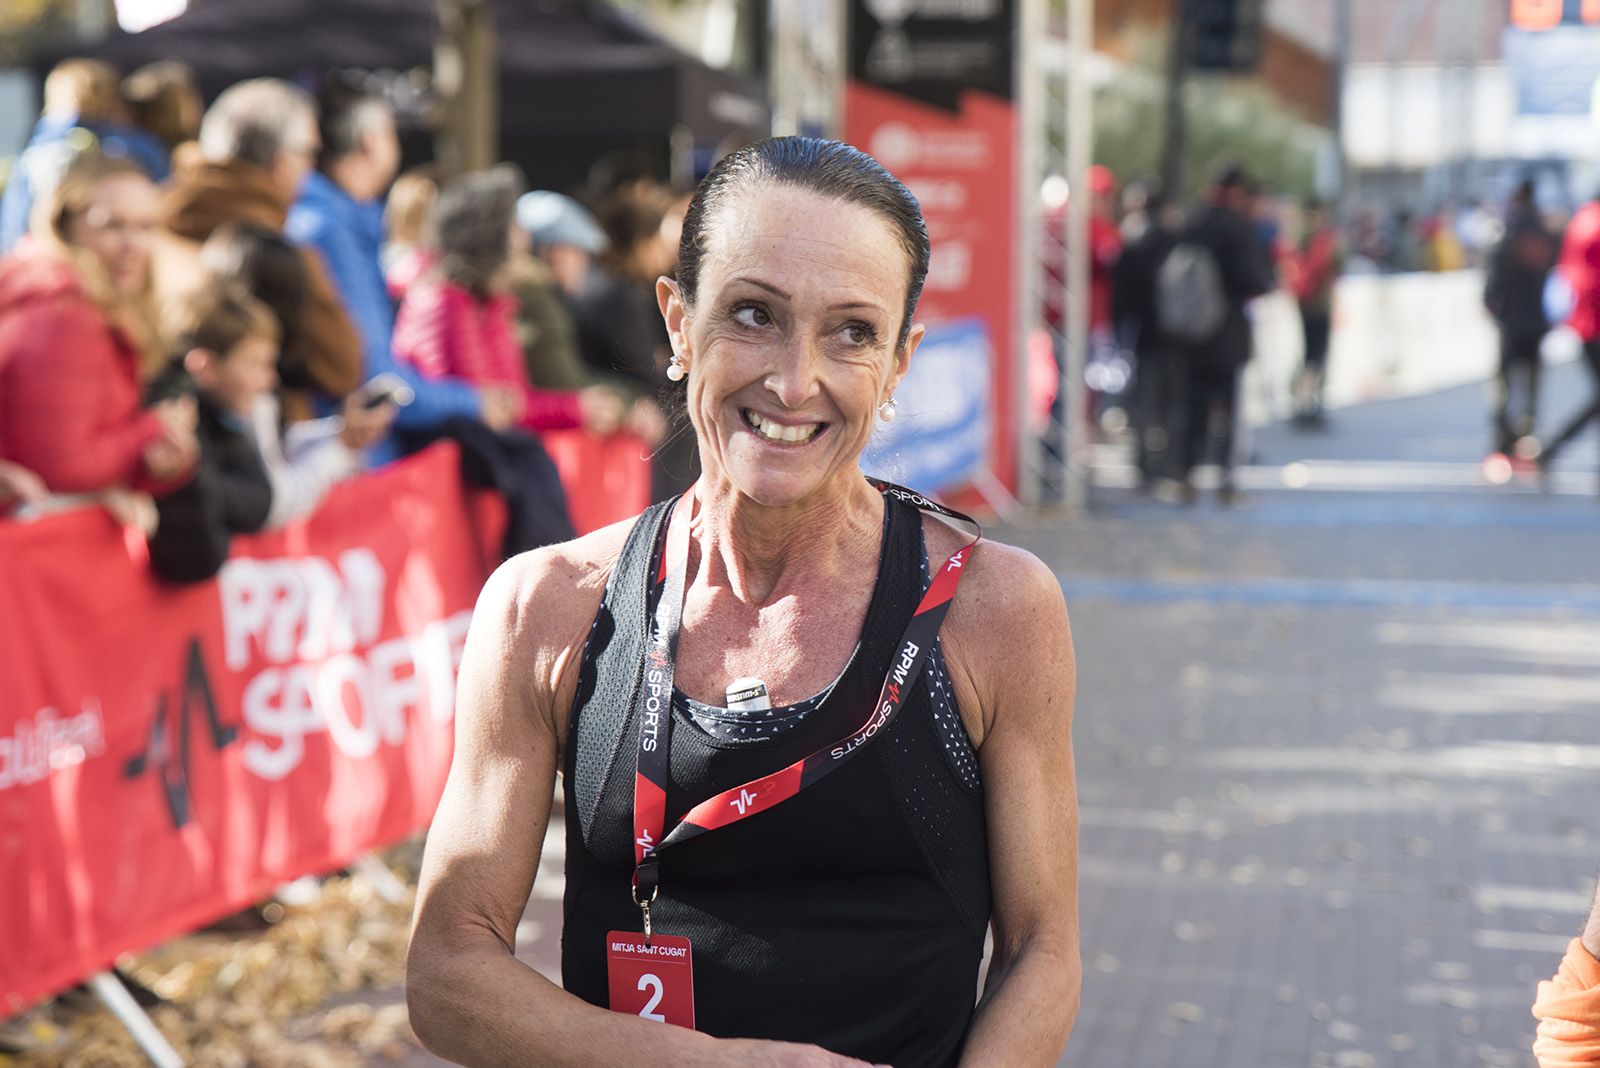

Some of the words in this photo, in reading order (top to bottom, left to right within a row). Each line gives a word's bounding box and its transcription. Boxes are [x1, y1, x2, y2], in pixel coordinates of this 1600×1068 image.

[893, 641, 919, 686] RPM
[643, 670, 662, 752] SPORTS
[831, 700, 892, 760] SPORTS
[612, 943, 635, 953] MITJA
[636, 945, 658, 955] SANT
[659, 946, 687, 957] CUGAT
[637, 973, 665, 1023] 2
